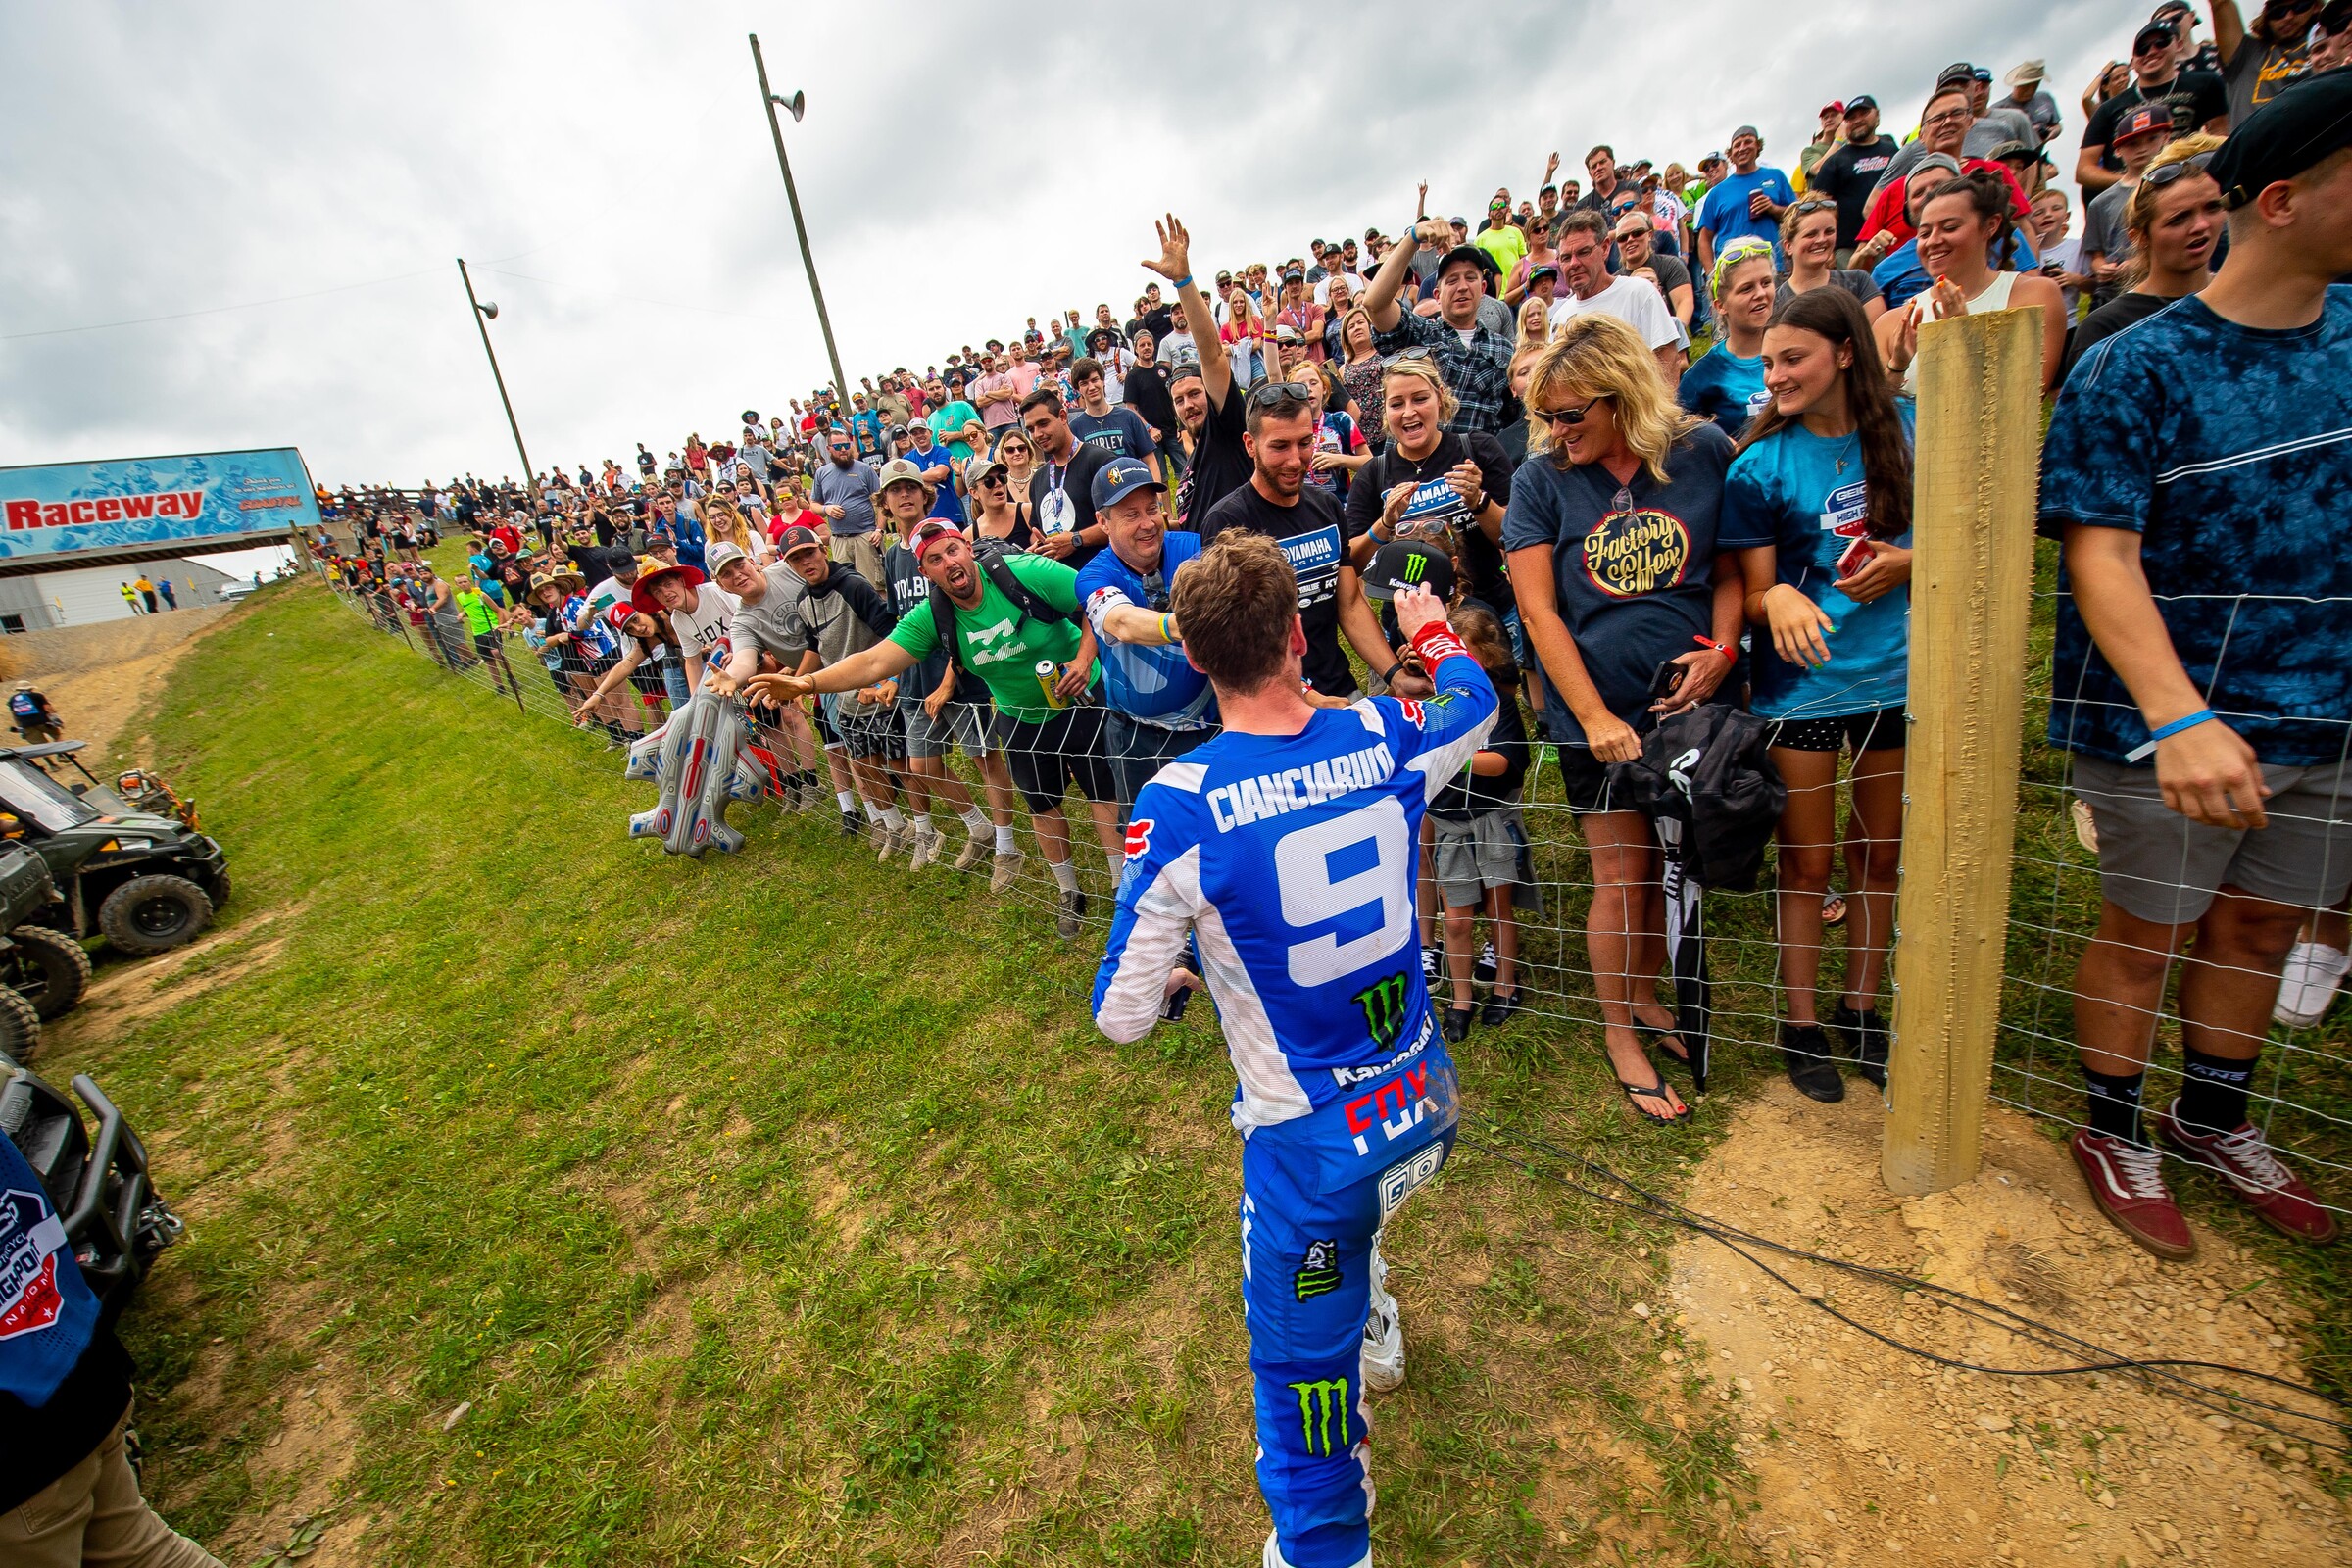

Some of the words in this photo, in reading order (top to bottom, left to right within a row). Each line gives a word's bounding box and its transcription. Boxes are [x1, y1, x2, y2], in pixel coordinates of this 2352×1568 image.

[1407, 492, 1457, 510] ACING
[1836, 484, 1868, 502] GEIC
[5, 491, 204, 530] Raceway
[1289, 537, 1332, 562] YAMAHA
[1584, 516, 1677, 571] Factory
[1293, 553, 1331, 568] ACING
[775, 602, 797, 634] PACIFI
[1274, 794, 1413, 989] 9
[2186, 1062, 2249, 1082] VANS
[1343, 1061, 1440, 1157] FOX
